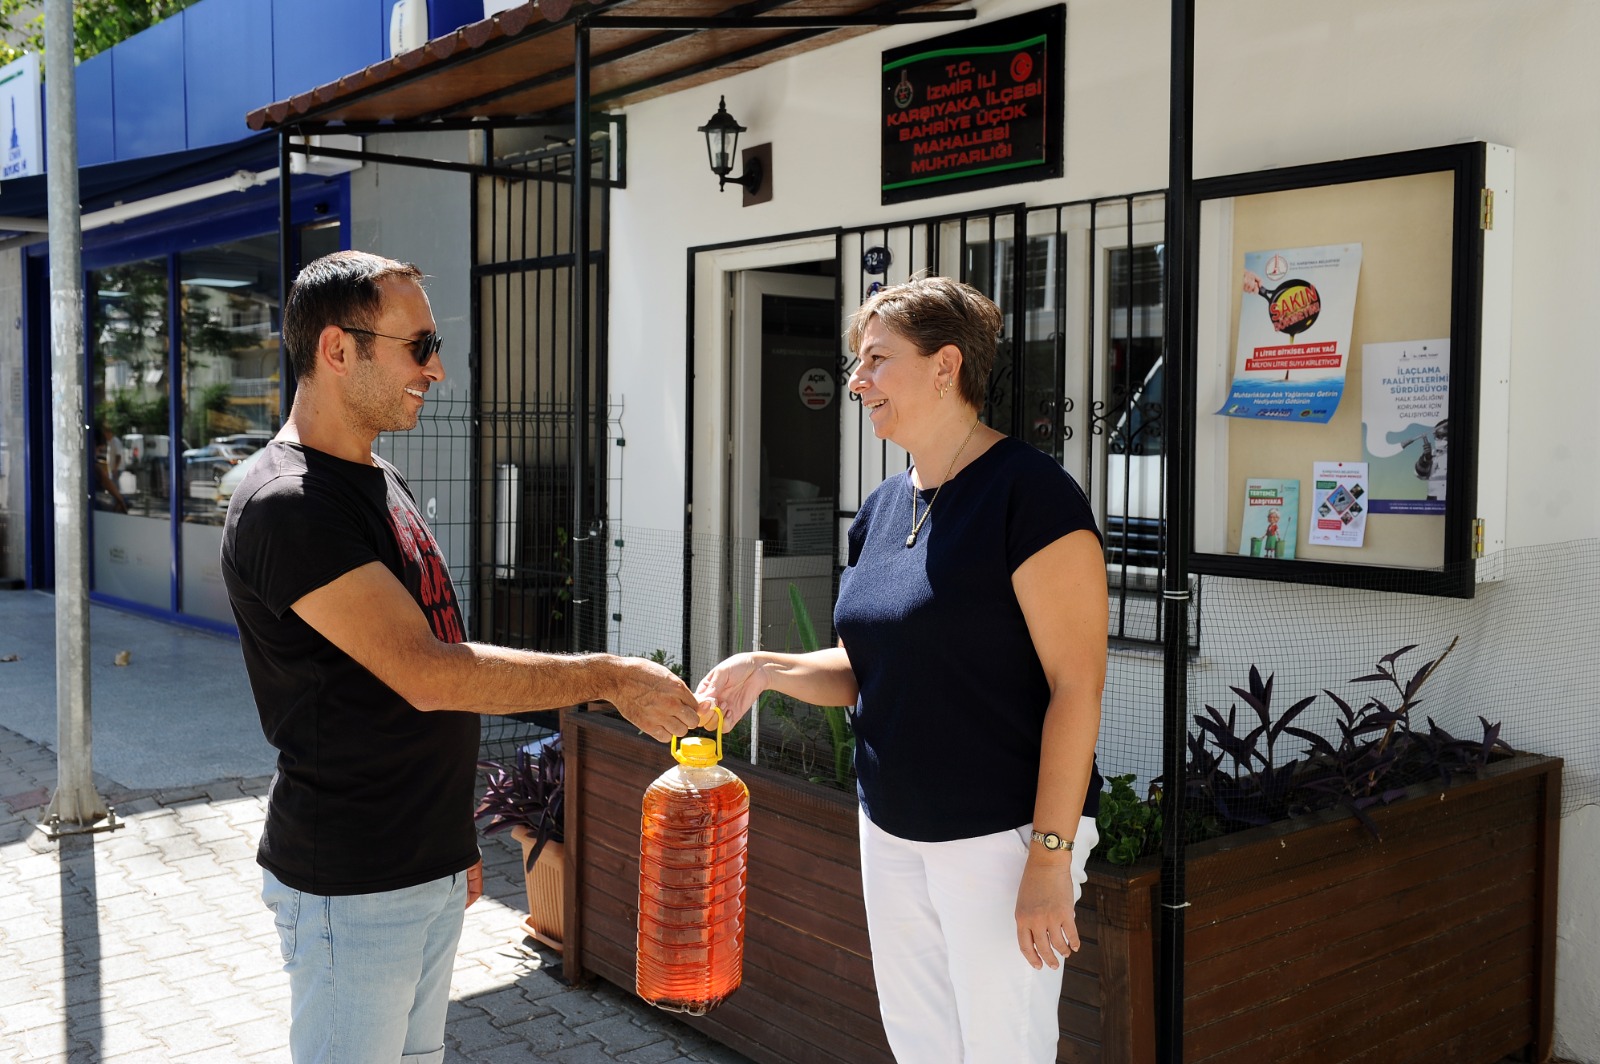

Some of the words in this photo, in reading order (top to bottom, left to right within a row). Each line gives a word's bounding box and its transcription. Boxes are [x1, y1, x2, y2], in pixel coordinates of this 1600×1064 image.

[945, 60, 976, 78] T.C.
[926, 78, 973, 101] İZMİR
[978, 69, 997, 90] İLİ
[886, 95, 981, 127] KARŞIYAKA
[986, 77, 1042, 106] İLÇESİ
[899, 115, 972, 142] BAHRİYE
[976, 103, 1028, 127] ÜÇOK
[913, 122, 1010, 156] MAHALLESİ
[910, 142, 1013, 174] MUHTARLIĞI
[1270, 284, 1318, 321] SAKIN
[1260, 349, 1277, 357] LİTRE
[1277, 347, 1305, 356] BİTKİSEL
[1306, 346, 1321, 354] ATIK
[1322, 345, 1335, 353] YAĞ
[1306, 358, 1340, 367] KİRLETİYOR
[808, 374, 826, 383] AÇIK
[1397, 366, 1441, 376] İLAÇLAMA
[1233, 391, 1270, 399] Muhtarlıklara
[1285, 391, 1315, 399] Yağlarınızı
[1316, 390, 1338, 398] Getirin
[1413, 394, 1444, 402] SAĞLIĞINI
[1399, 411, 1440, 419] ÇALIŞIYORUZ
